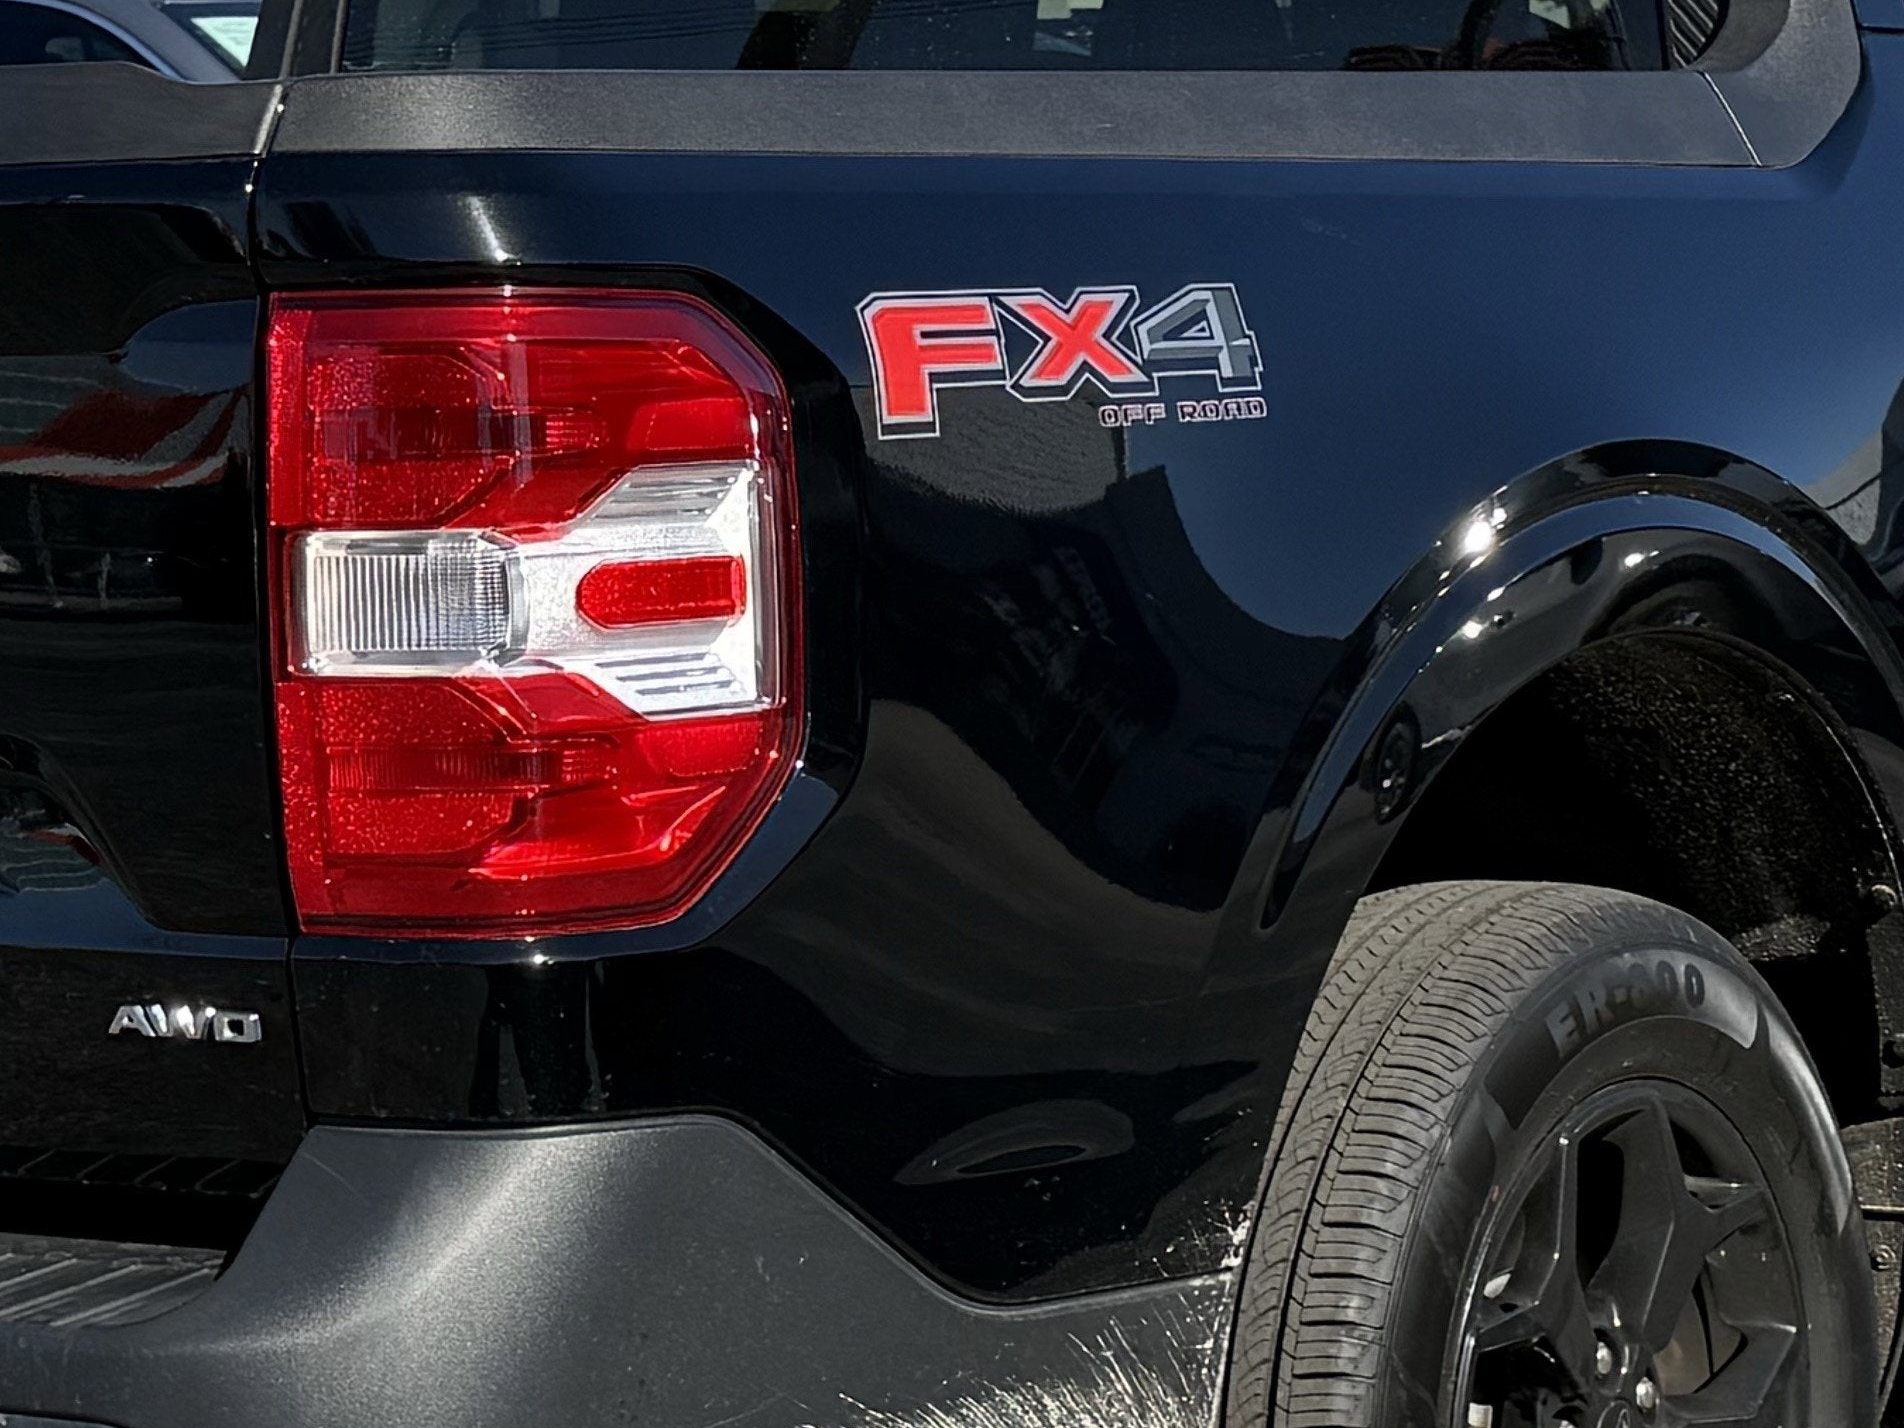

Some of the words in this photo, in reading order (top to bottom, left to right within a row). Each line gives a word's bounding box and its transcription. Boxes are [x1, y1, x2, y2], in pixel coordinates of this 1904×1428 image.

[855, 283, 1264, 440] FX4
[1099, 402, 1166, 428] OFF
[1177, 396, 1267, 423] ROAD
[108, 1003, 262, 1043] AWD
